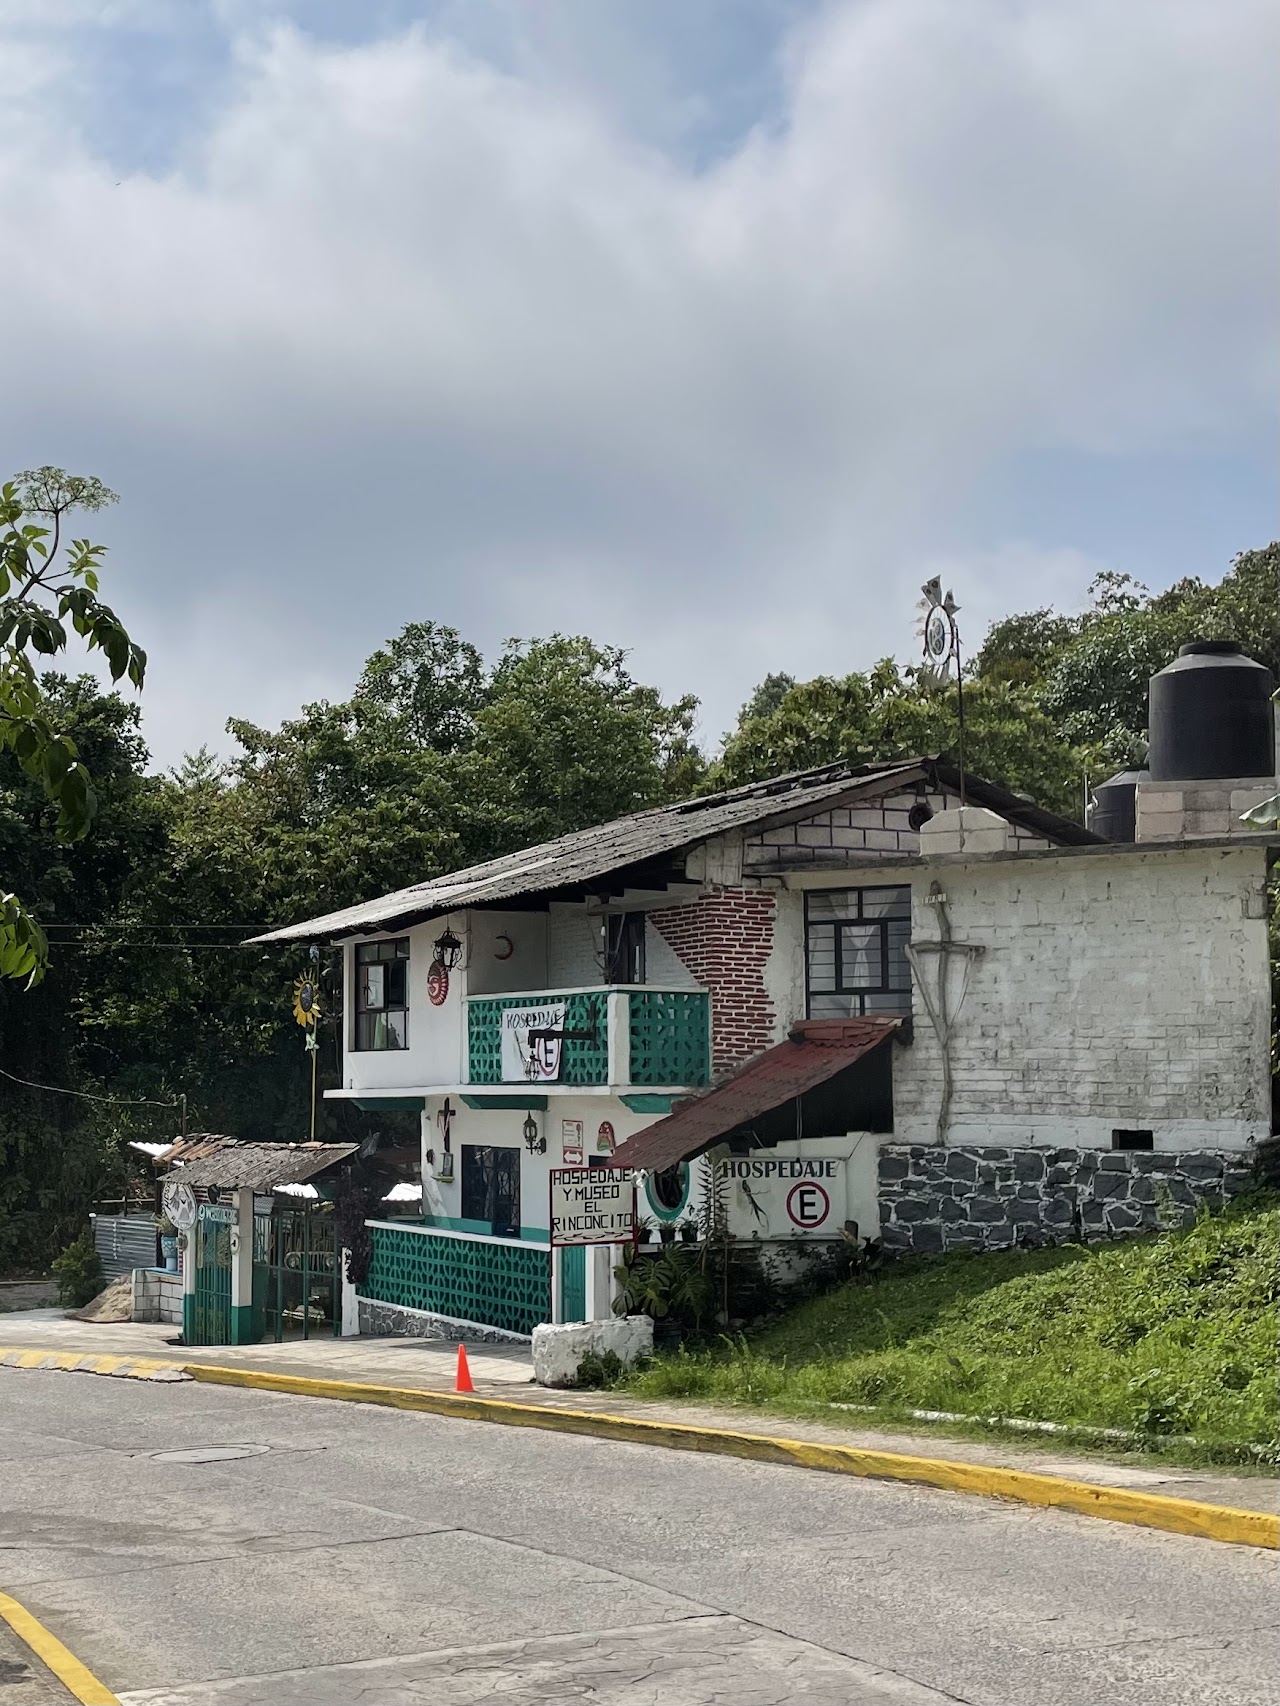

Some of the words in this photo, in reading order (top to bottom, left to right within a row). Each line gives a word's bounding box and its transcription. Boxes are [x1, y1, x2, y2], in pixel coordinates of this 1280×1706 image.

[553, 1168, 631, 1185] HOSPEDAJE
[723, 1160, 838, 1178] HOSPEDAJE
[575, 1185, 620, 1201] MUSEO
[584, 1201, 603, 1213] EL
[798, 1189, 818, 1221] E
[552, 1213, 633, 1232] RINCONCITO
